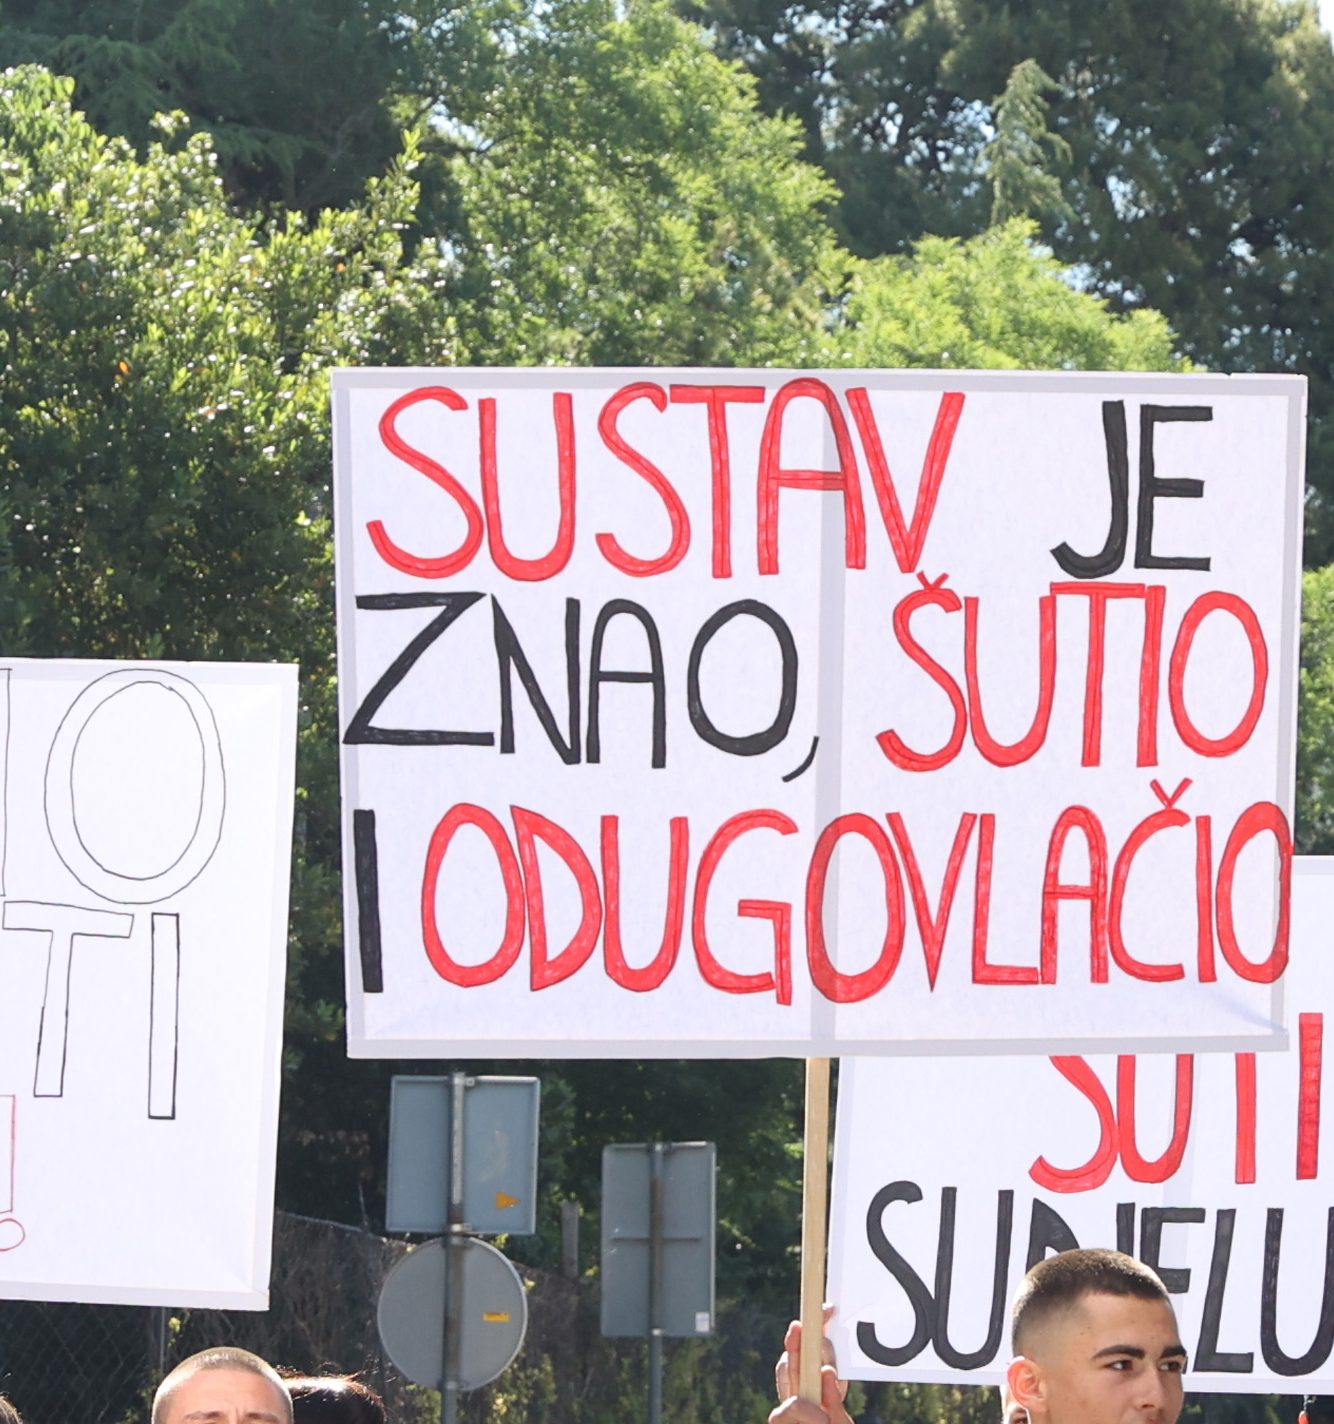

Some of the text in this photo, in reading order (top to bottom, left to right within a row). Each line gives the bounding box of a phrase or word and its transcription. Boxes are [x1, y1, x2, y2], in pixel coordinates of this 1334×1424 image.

[366, 377, 1214, 582] SUSTAV JE
[342, 571, 1268, 783] ZNAO, ŠUTIO
[353, 777, 1294, 1007] I ODUGOVLAČIO
